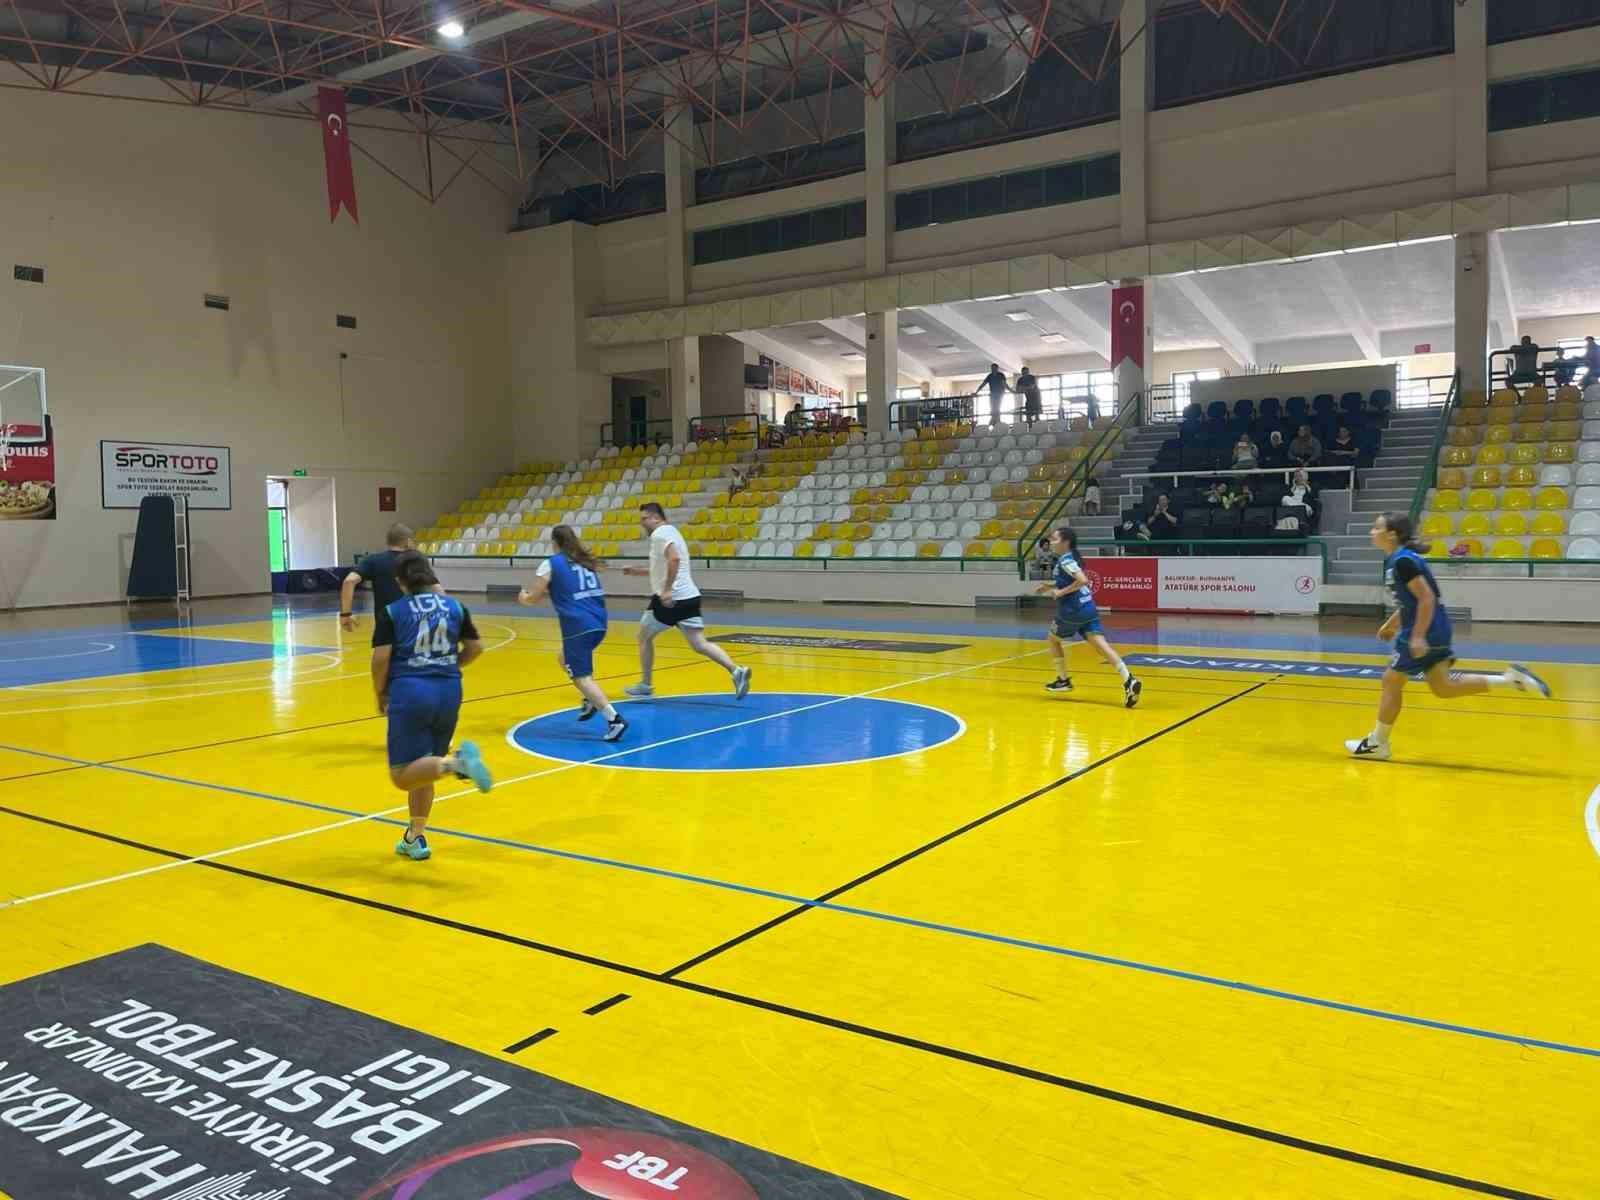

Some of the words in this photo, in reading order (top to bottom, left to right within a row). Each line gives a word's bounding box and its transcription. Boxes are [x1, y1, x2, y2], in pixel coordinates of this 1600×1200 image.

[115, 452, 218, 470] SPORTOTO
[571, 562, 598, 590] 75
[1164, 583, 1199, 592] ATATÜRK
[1200, 584, 1222, 592] SPOR
[1223, 584, 1256, 593] SALONU
[414, 617, 451, 658] 44
[23, 1021, 199, 1104] KADINLAR
[89, 998, 443, 1155] BASKETBOL
[342, 1048, 512, 1116] LİGİ
[170, 1091, 358, 1185] TÜRKİYE
[602, 1150, 689, 1191] TBF
